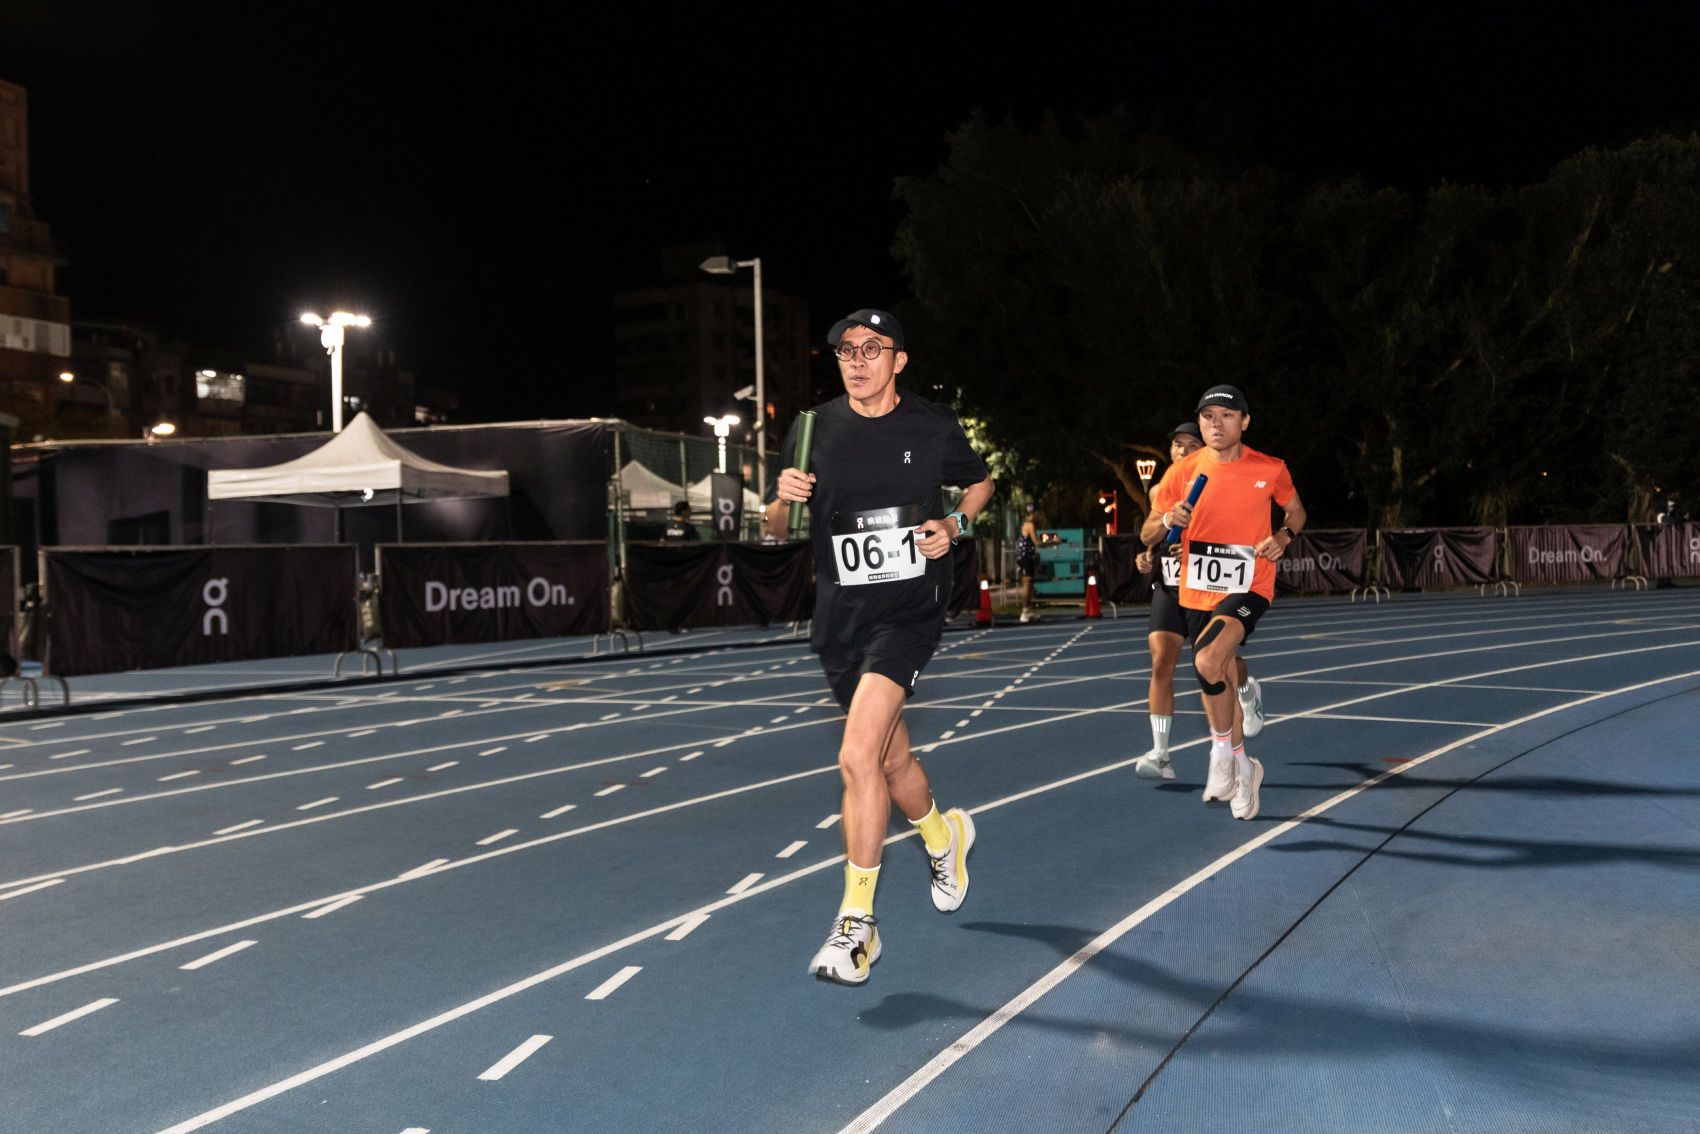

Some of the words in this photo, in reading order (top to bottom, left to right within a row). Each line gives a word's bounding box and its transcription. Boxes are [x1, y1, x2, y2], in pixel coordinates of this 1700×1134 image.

[841, 530, 917, 572] 06-1
[1277, 556, 1311, 573] ream
[1528, 547, 1577, 564] Dream
[1580, 545, 1608, 562] On.
[1193, 557, 1246, 586] 10-1
[425, 580, 521, 612] Dream
[527, 576, 576, 607] On.
